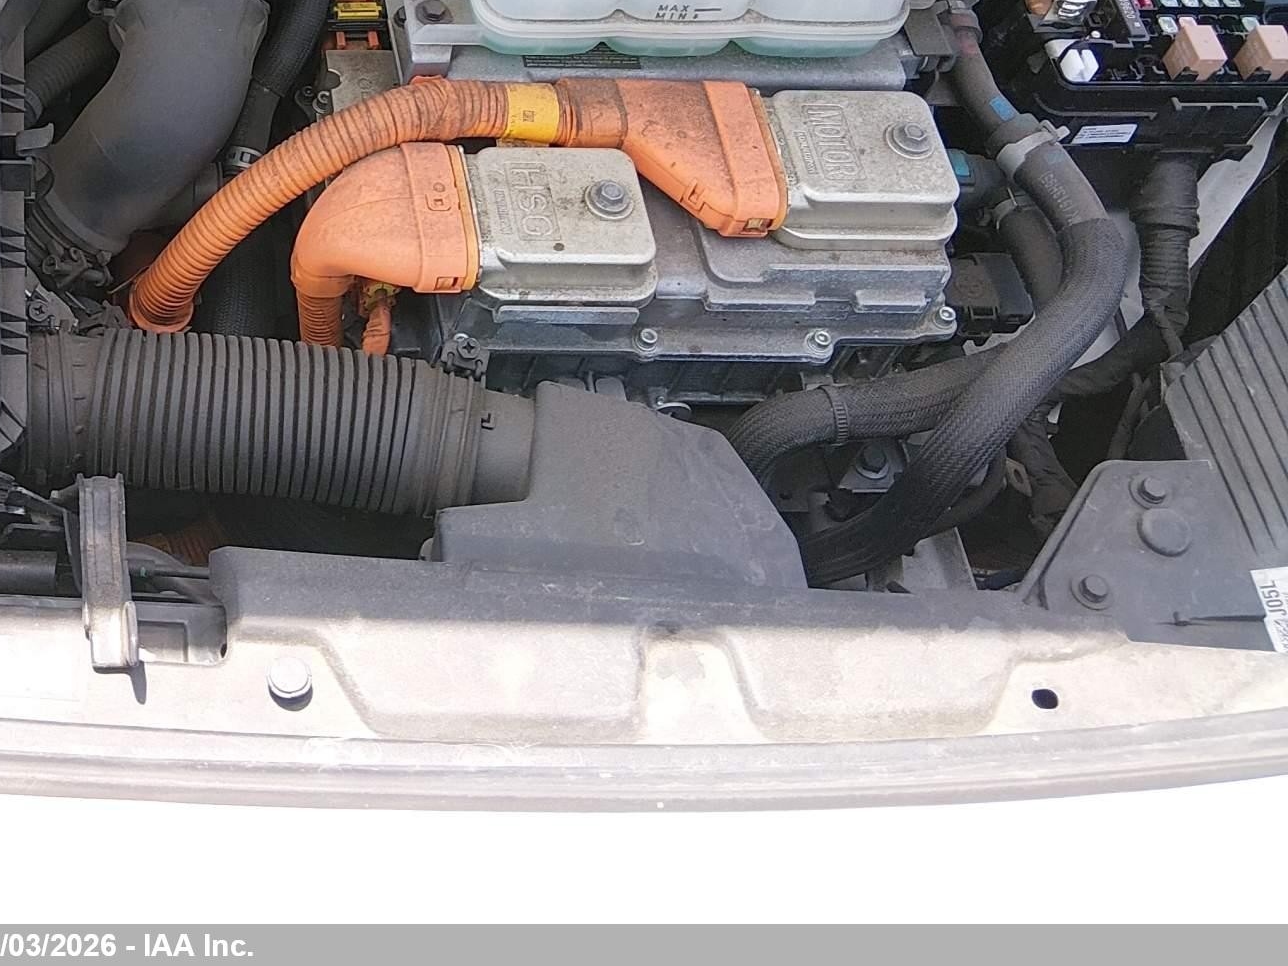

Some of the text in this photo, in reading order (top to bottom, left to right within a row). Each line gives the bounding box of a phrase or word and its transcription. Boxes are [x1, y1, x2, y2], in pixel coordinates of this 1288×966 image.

[655, 12, 688, 20] MIN
[657, 4, 690, 12] MAX
[806, 108, 859, 181] MOTOR
[510, 166, 554, 237] HSG
